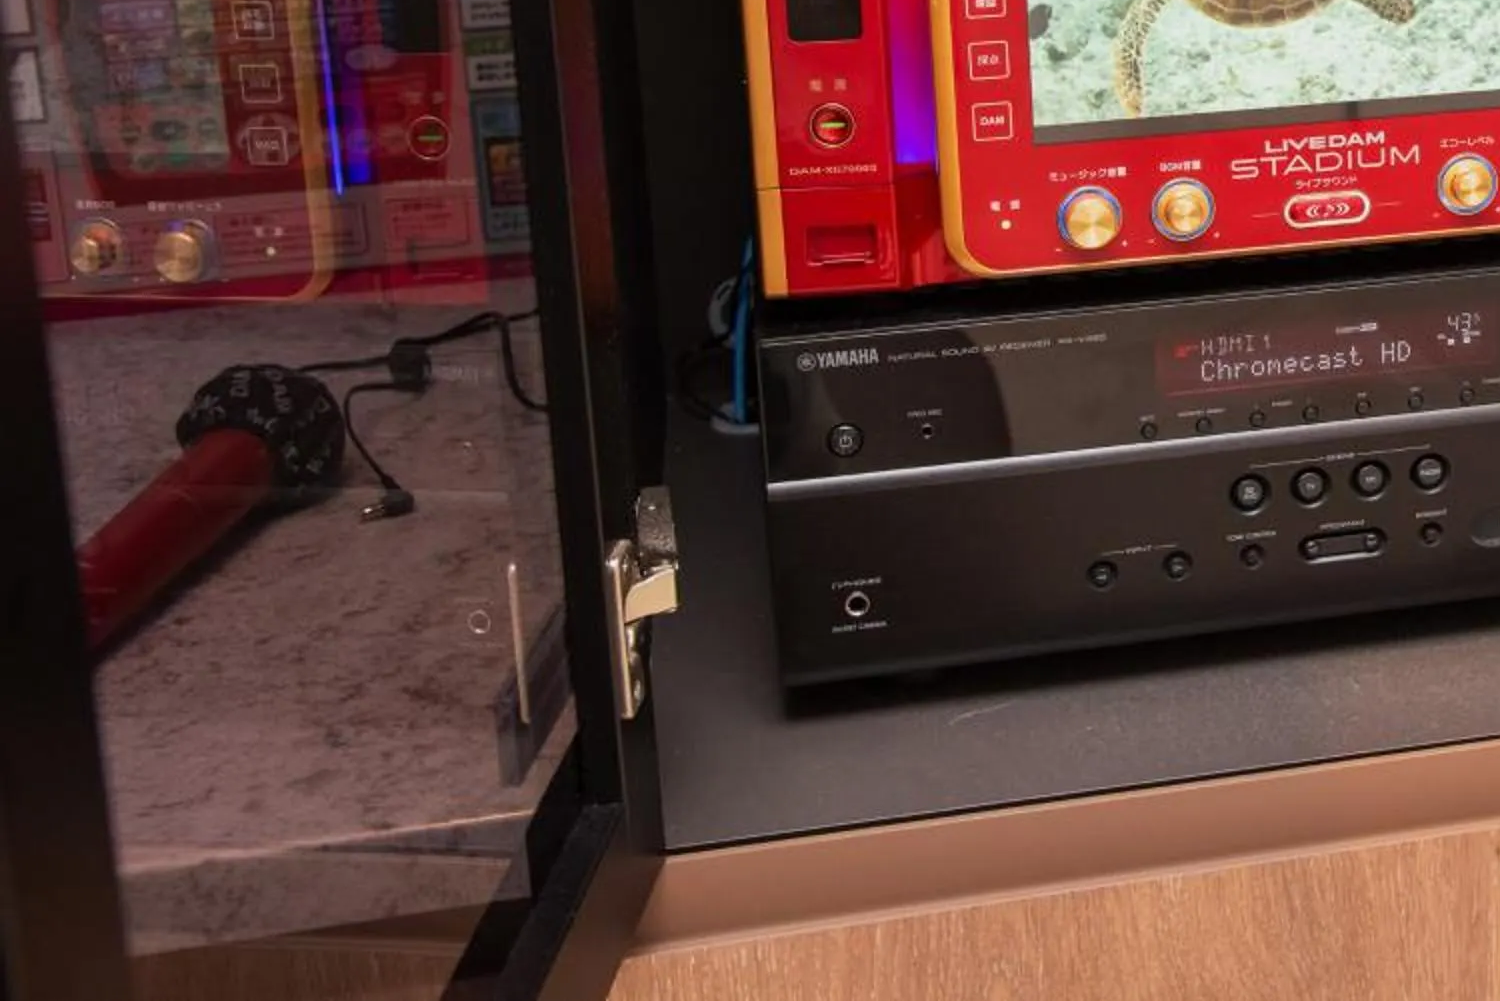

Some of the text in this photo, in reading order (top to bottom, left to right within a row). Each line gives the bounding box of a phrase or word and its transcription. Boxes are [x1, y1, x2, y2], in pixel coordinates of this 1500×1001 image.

[1264, 130, 1385, 154] LIVEDAM
[1231, 144, 1421, 181] STADIUM
[816, 347, 879, 368] YAMAHA
[941, 346, 979, 357] SOUND
[1200, 340, 1412, 383] Chromecast HD
